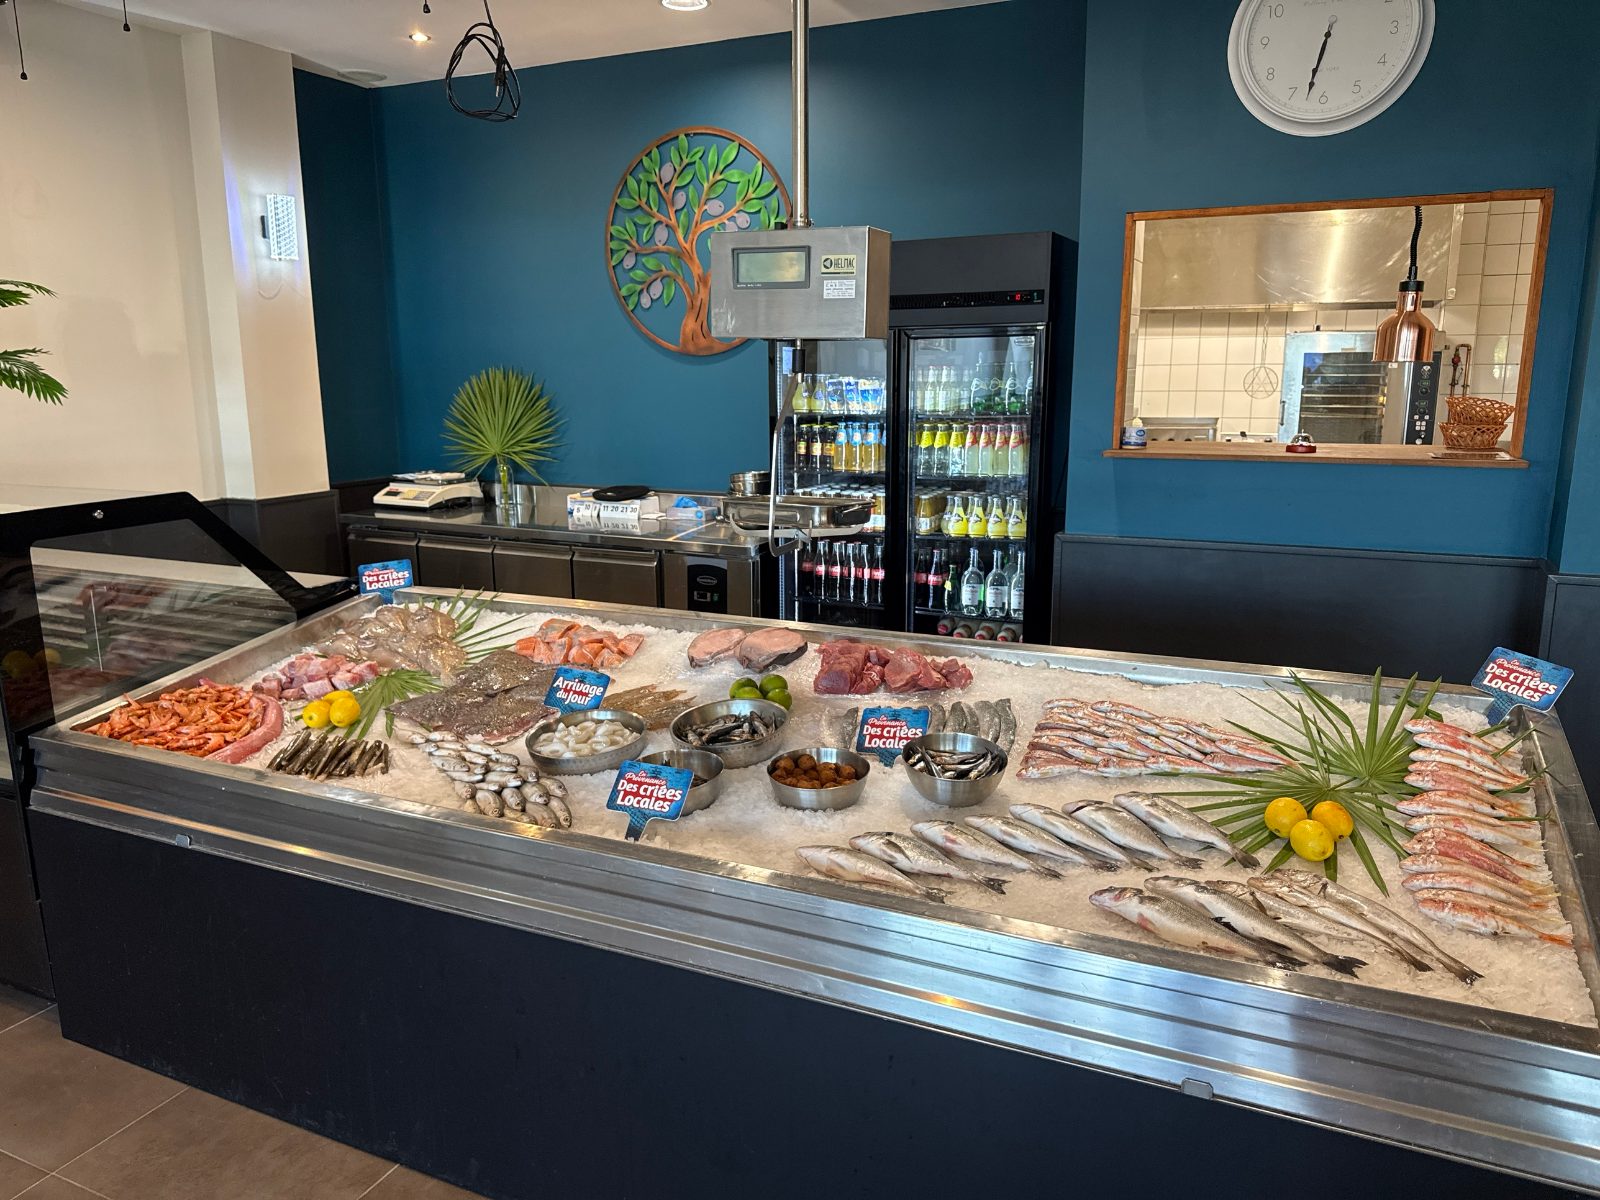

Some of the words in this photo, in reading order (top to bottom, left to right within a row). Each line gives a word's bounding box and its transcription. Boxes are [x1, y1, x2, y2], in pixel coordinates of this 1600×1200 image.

[1266, 4, 1285, 19] 10
[1389, 20, 1399, 34] 3
[1260, 36, 1270, 49] 9
[1377, 53, 1387, 66] 4
[1266, 68, 1275, 81] 8
[1288, 87, 1298, 100] 7
[1352, 80, 1362, 94] 5
[1318, 91, 1329, 104] 6
[362, 575, 377, 583] Des
[366, 579, 405, 590] Locales
[1485, 663, 1509, 677] Des
[553, 677, 604, 697] Arrivage
[556, 689, 568, 698] du
[1483, 674, 1542, 702] Locales
[863, 725, 882, 735] Des
[864, 735, 911, 748] Locale
[617, 780, 638, 792] Des
[617, 791, 671, 812] Locales
